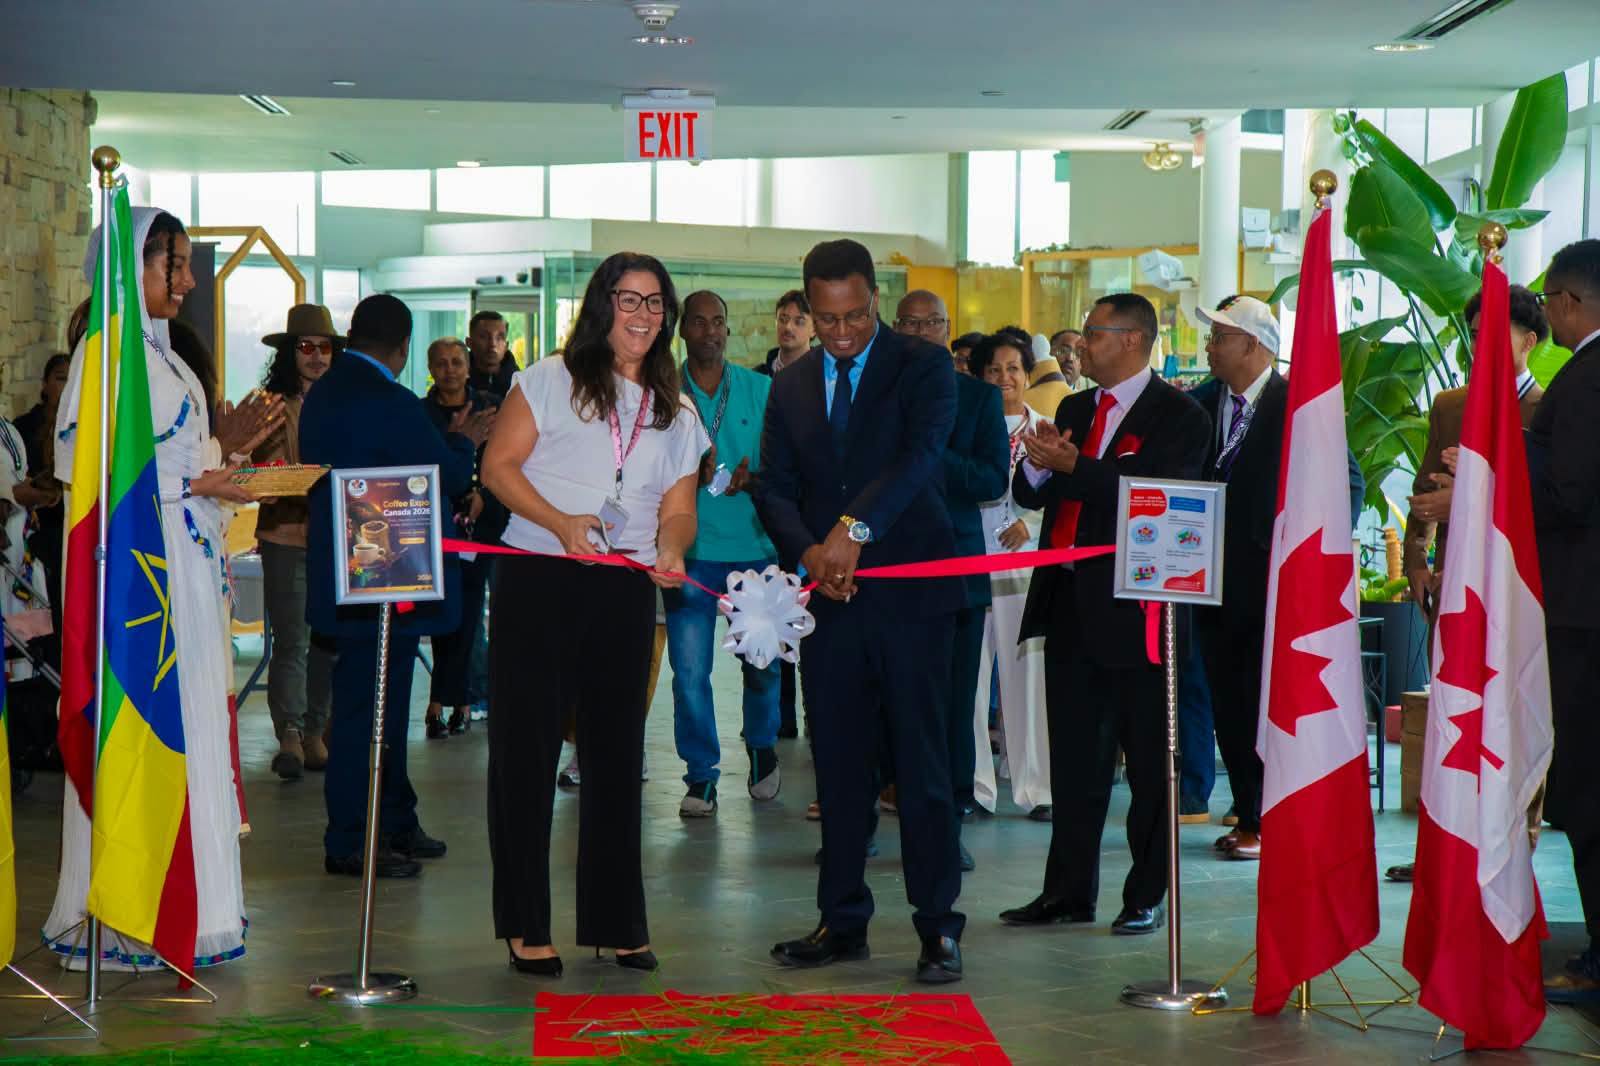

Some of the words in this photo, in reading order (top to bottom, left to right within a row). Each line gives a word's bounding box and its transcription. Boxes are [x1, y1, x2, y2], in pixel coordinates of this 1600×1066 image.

[638, 112, 698, 158] EXIT
[383, 499, 408, 508] Coffee
[409, 499, 430, 508] Expo
